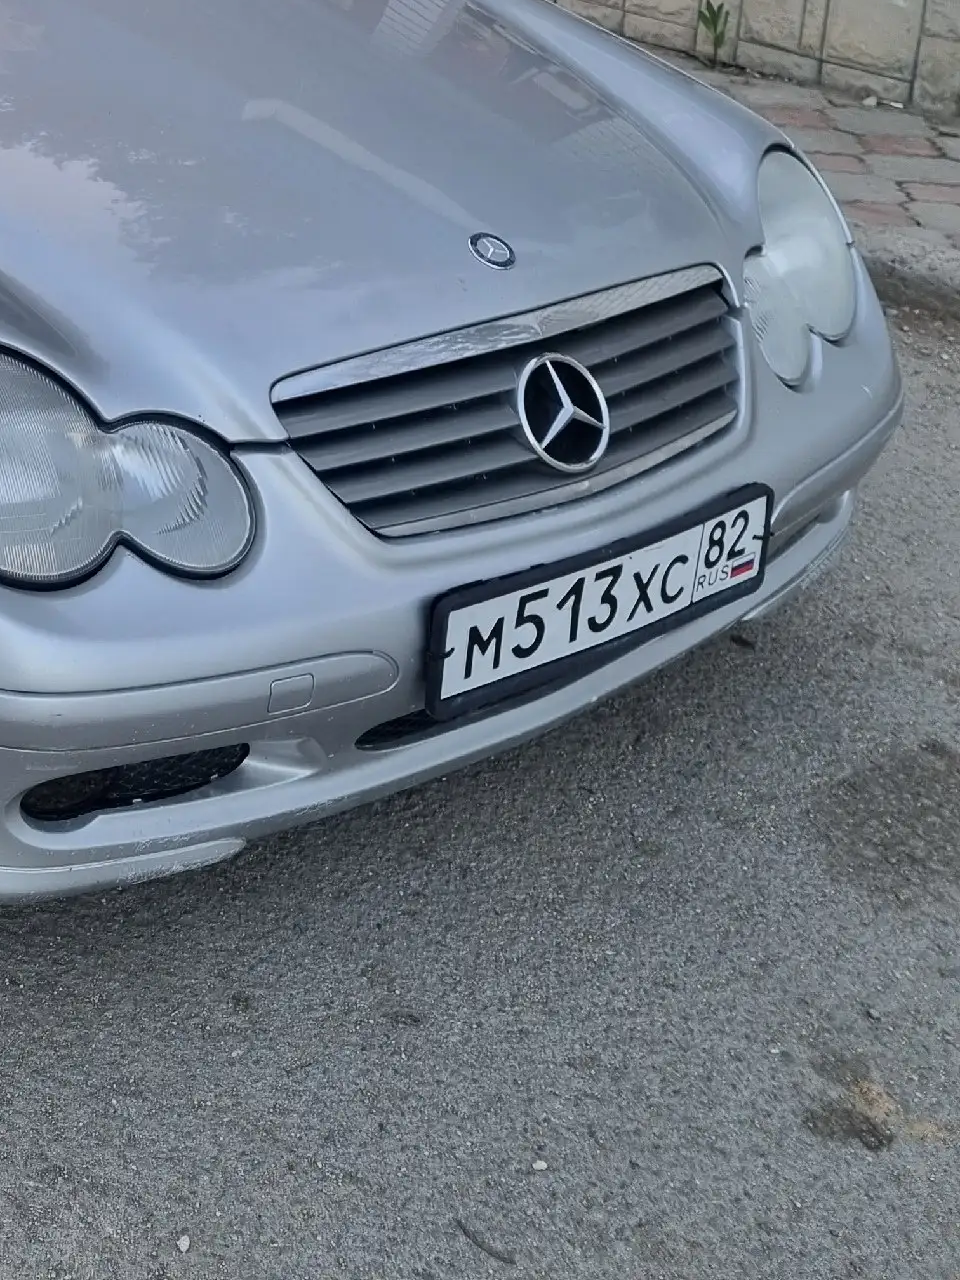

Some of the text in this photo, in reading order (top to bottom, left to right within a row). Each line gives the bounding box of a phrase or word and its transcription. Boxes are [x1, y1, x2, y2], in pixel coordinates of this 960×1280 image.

[463, 509, 751, 680] М513ХС 82
[696, 564, 730, 592] RUS
